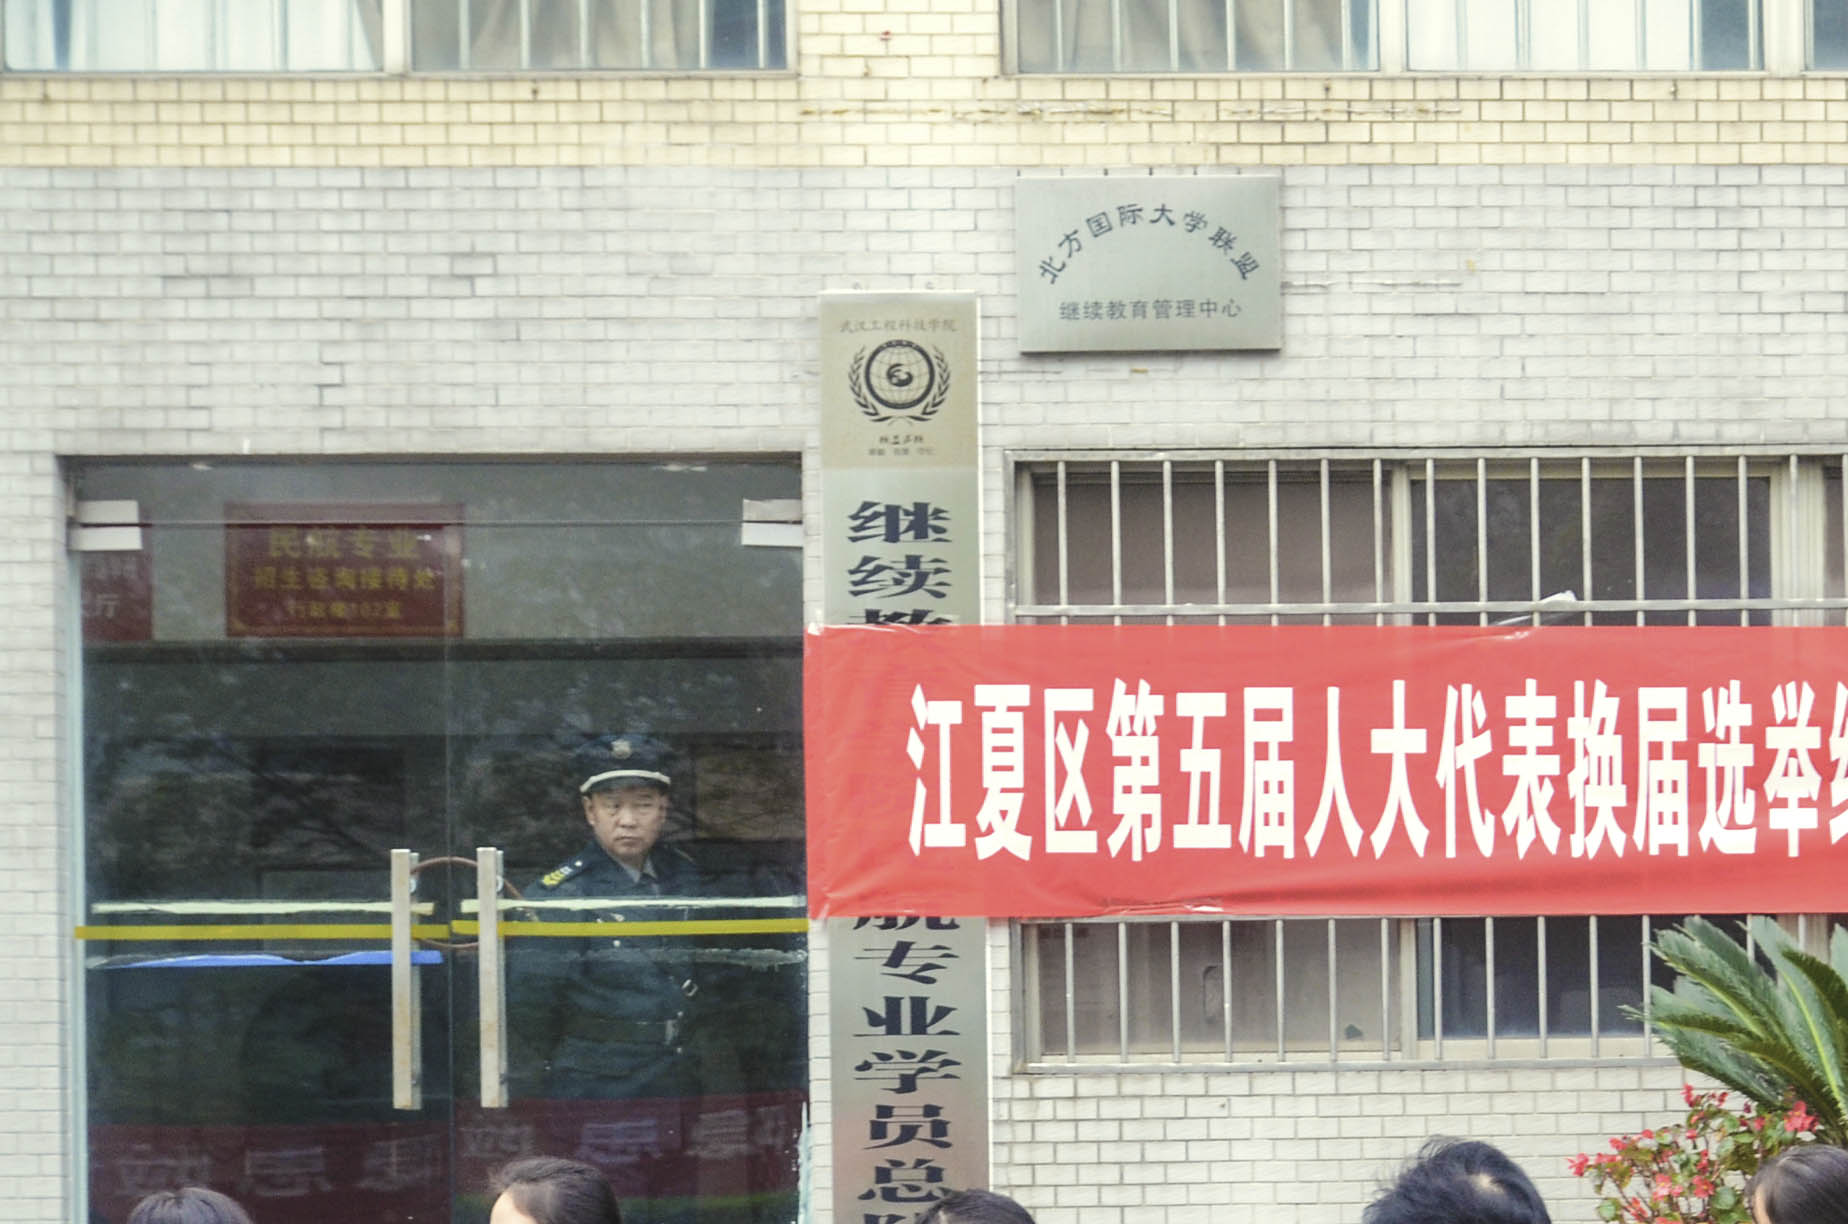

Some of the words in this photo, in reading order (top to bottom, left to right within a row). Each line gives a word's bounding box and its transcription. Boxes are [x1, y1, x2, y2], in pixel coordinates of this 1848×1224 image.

[1038, 203, 1260, 284] 北方国际大学联盟
[1058, 299, 1243, 321] 继续教育管理中心
